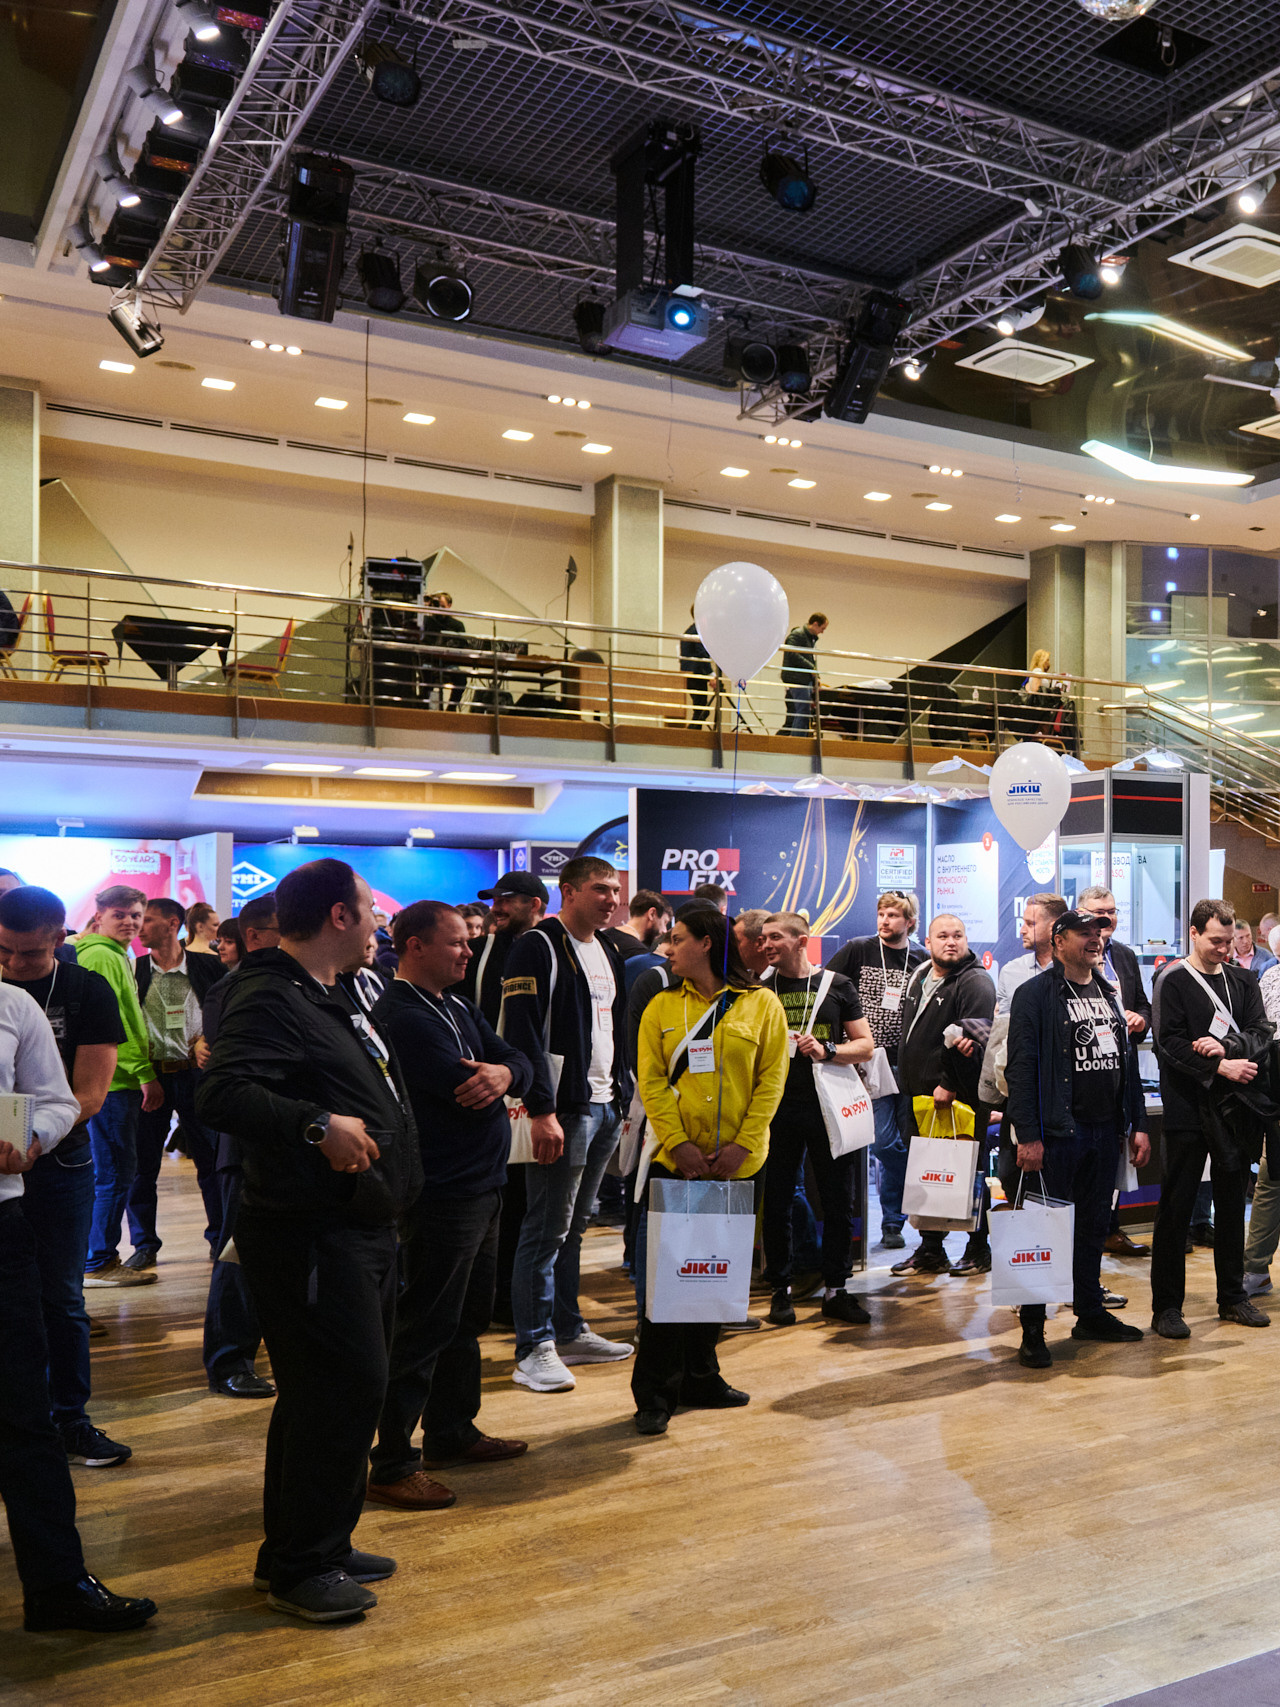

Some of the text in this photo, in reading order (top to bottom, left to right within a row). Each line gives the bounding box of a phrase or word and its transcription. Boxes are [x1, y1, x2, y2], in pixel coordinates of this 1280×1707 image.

[1008, 785, 1040, 794] JIKIU
[661, 848, 720, 871] PRO
[937, 854, 955, 863] МАСЛО
[942, 864, 977, 874] ВНУТРЕННЕГО
[689, 870, 739, 891] FIX
[937, 875, 968, 885] ЯПОНСКОГО
[937, 887, 955, 896] РЫНКА
[1075, 1059, 1114, 1072] LOOKS
[921, 1172, 954, 1183] JIKIU
[1011, 1251, 1051, 1264] JIKIU
[680, 1262, 728, 1274] JIKIU
